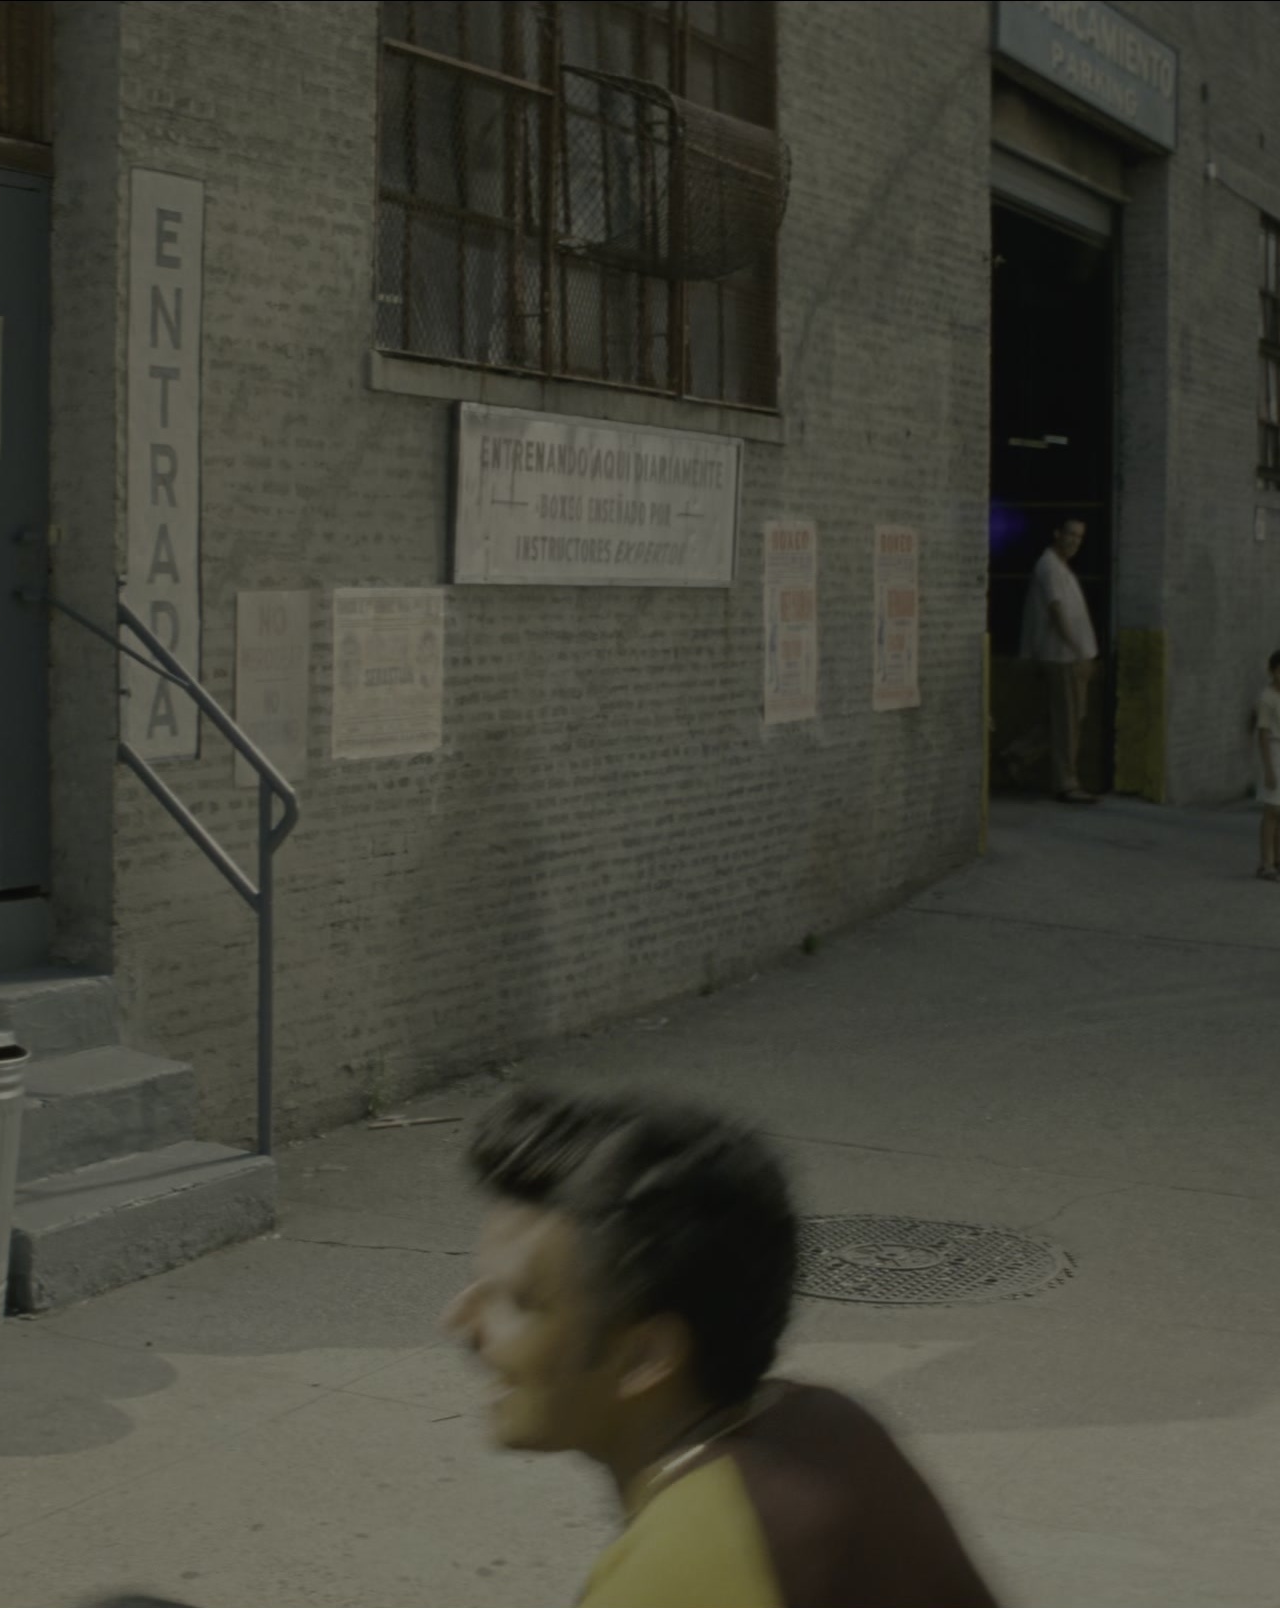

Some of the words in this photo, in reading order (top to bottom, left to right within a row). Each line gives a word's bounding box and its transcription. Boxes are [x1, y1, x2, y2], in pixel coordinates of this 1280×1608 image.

[480, 435, 588, 478] ENTRENANDO
[633, 452, 723, 490] DIARIAMENTE
[540, 493, 582, 522] BOXEO
[649, 501, 672, 527] POR
[516, 535, 610, 564] INSTRUCTORES
